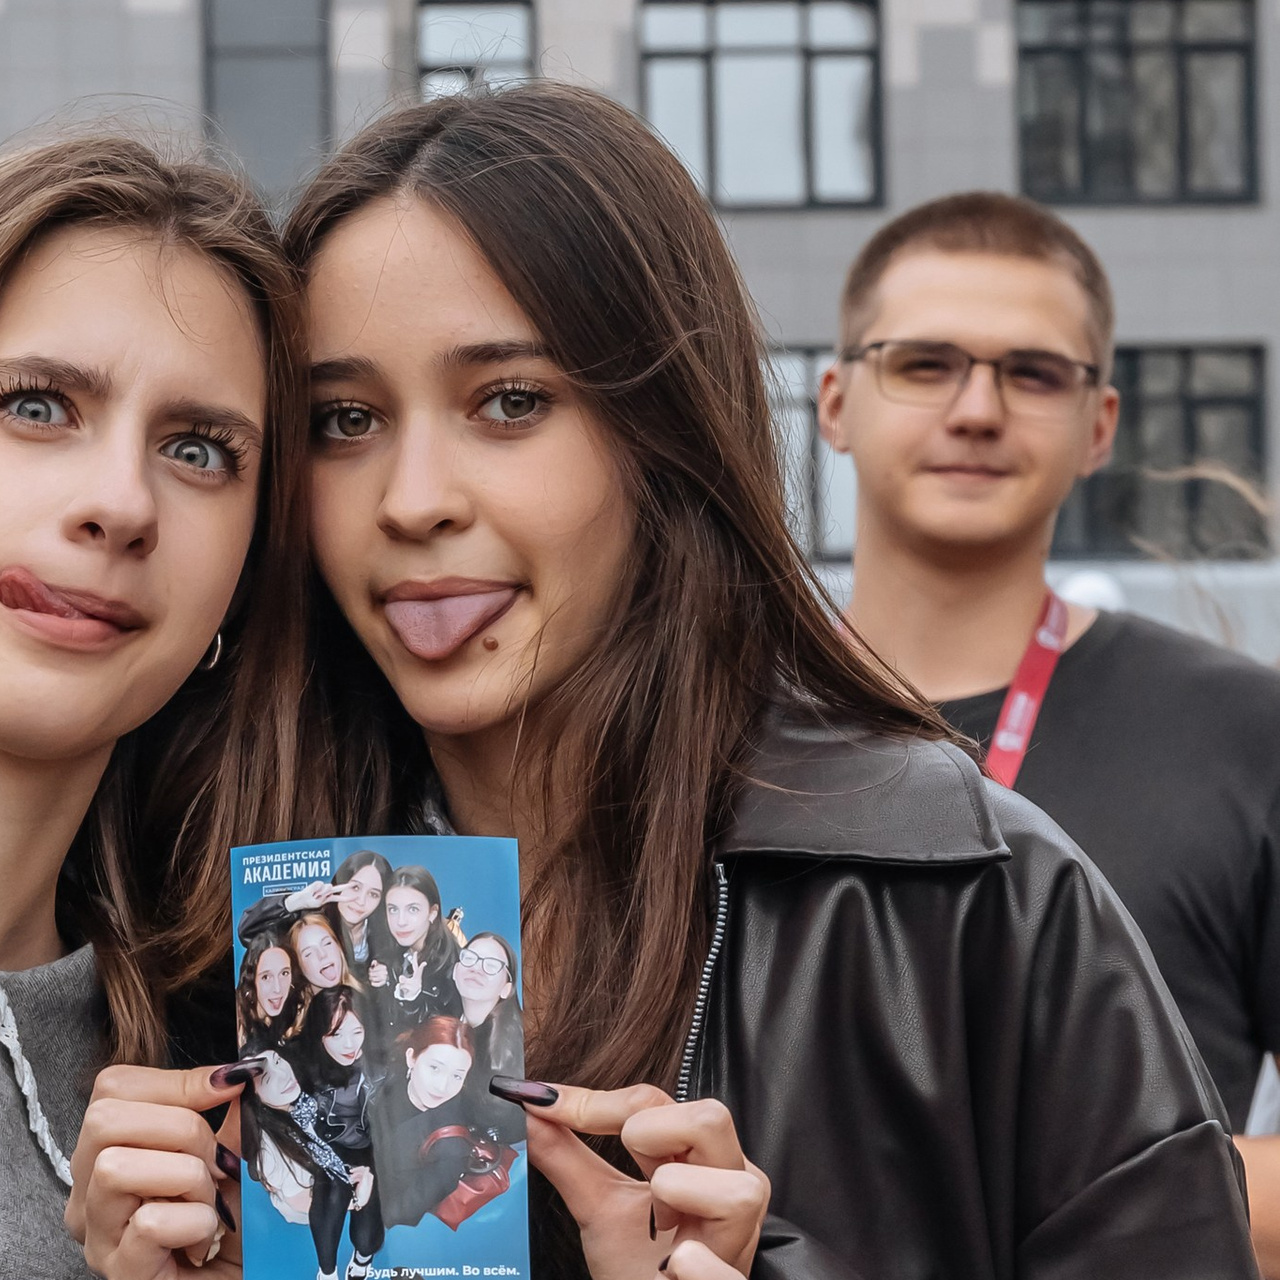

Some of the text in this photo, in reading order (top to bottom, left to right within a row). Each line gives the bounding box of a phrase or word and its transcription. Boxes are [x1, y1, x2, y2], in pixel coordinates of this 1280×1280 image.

[242, 849, 331, 866] ПРЕЗИДЕНТСКАЯ
[243, 860, 331, 885] АКАДЕМИЯ
[366, 1264, 521, 1280] Будь лучшим. Во всём.
